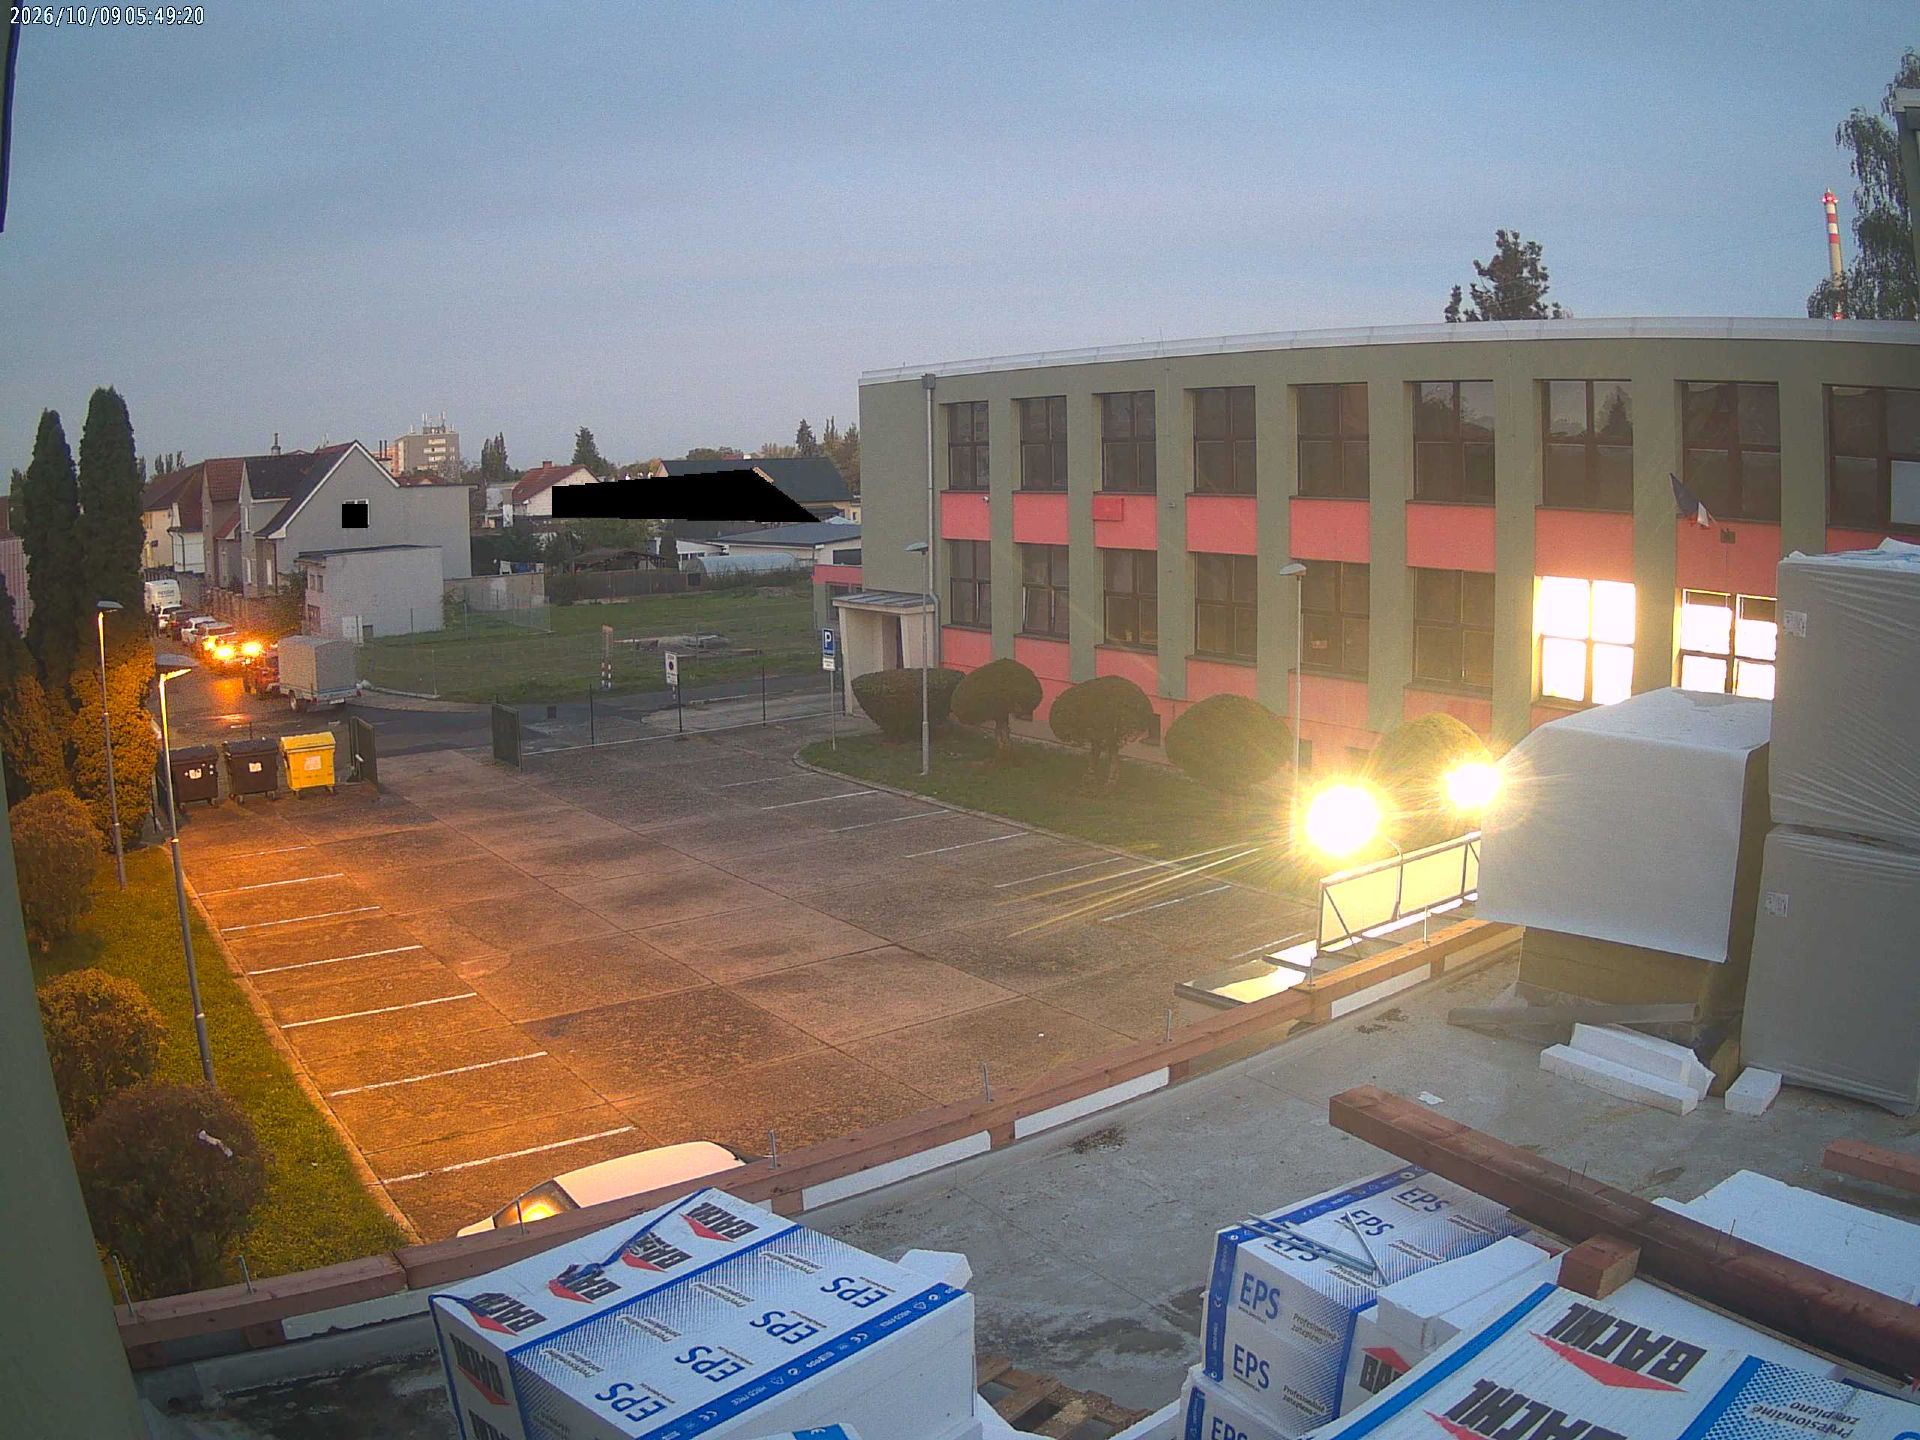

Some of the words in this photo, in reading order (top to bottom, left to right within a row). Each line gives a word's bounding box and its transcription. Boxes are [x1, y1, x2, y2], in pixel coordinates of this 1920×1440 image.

[824, 631, 832, 648] P
[1396, 1186, 1450, 1213] EPS
[688, 1202, 760, 1240] BACHL
[820, 1276, 889, 1308] EPS
[1239, 1271, 1281, 1320] EPS
[749, 1310, 820, 1345] EPS
[1545, 1302, 1708, 1385] BACHL
[674, 1345, 746, 1383] EPS
[1233, 1343, 1270, 1390] EPS
[595, 1382, 668, 1423] EPS
